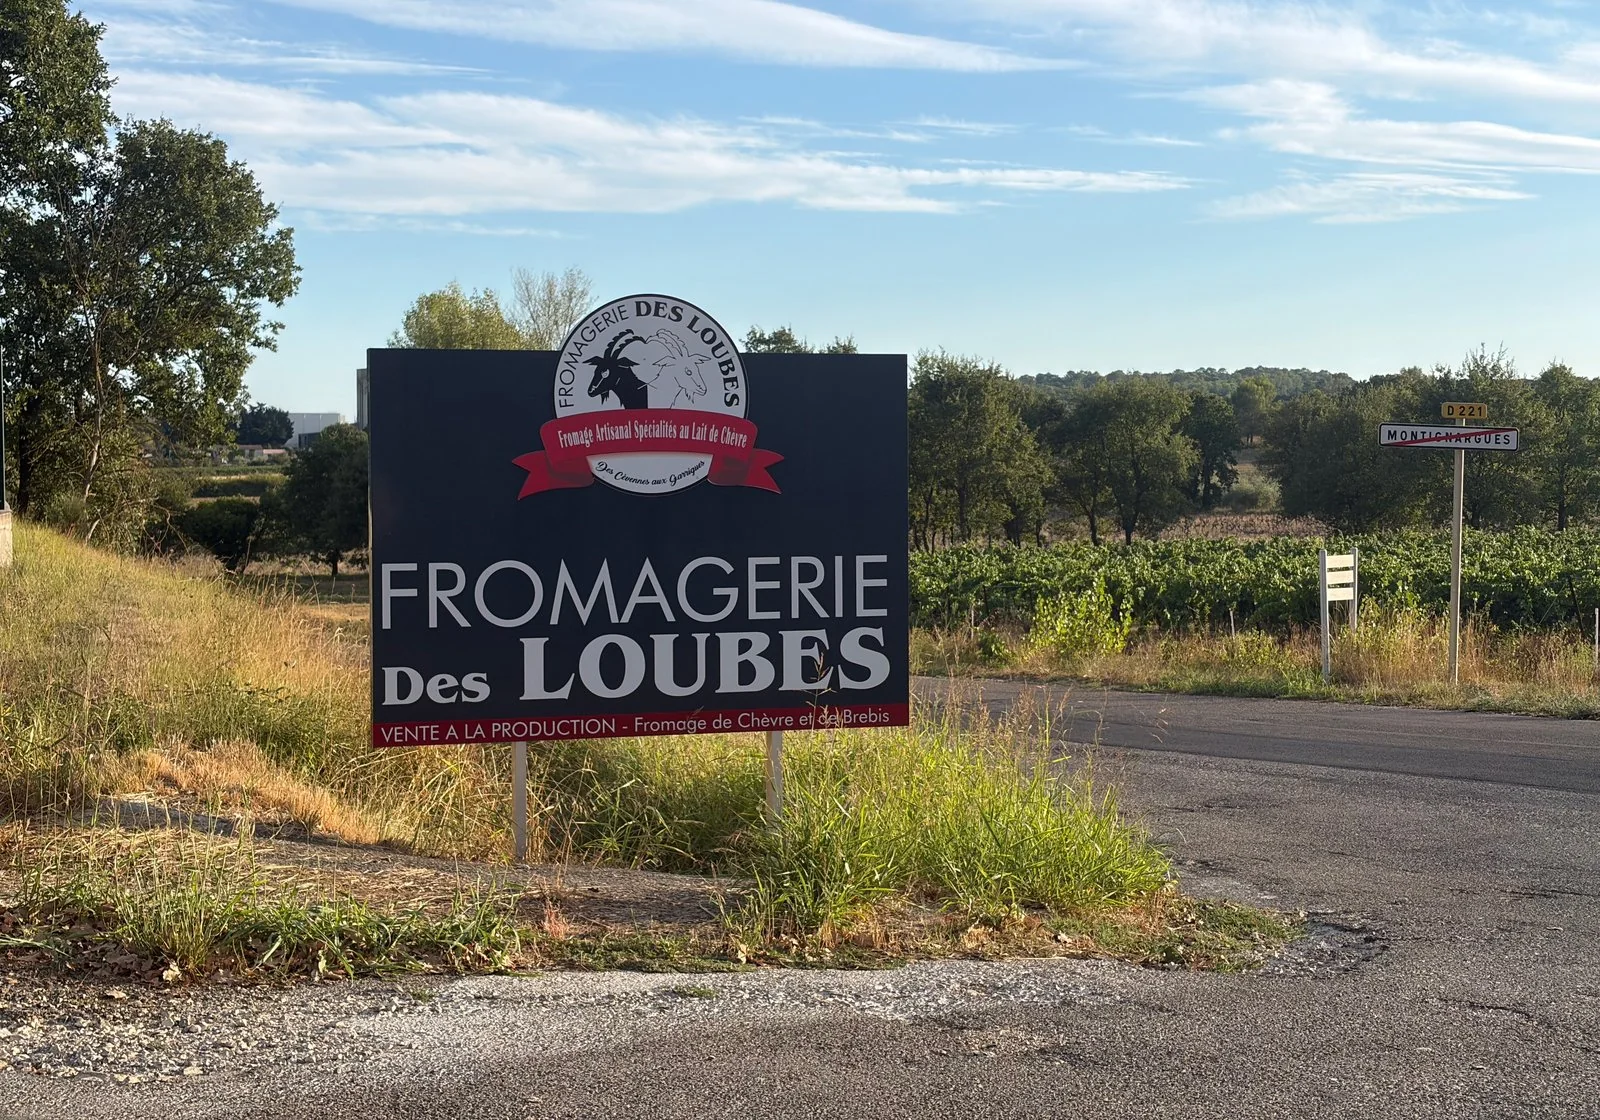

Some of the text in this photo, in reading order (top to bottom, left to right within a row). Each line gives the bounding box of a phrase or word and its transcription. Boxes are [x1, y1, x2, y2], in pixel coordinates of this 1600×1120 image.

[558, 300, 740, 408] FROMAGERIE DES LOUBES
[1447, 405, 1482, 417] D 221
[557, 426, 594, 449] Fromage
[595, 420, 632, 442] Artisanal
[634, 419, 677, 442] Spécialités
[680, 424, 689, 440] au
[692, 421, 707, 441] Lait
[709, 424, 719, 443] de
[595, 461, 614, 475] Des
[669, 460, 705, 487] Garrigues
[381, 554, 888, 630] FROMAGERIE
[382, 626, 891, 706] Des LOUBES
[381, 725, 439, 743] VENTE
[445, 725, 459, 740] A
[464, 723, 486, 739] LA
[492, 718, 616, 738] PRODUCTION
[634, 716, 707, 734] Fromage
[712, 713, 732, 729] de
[737, 712, 794, 729] Chèvre
[799, 712, 813, 726] et
[843, 707, 890, 724] Brebis
